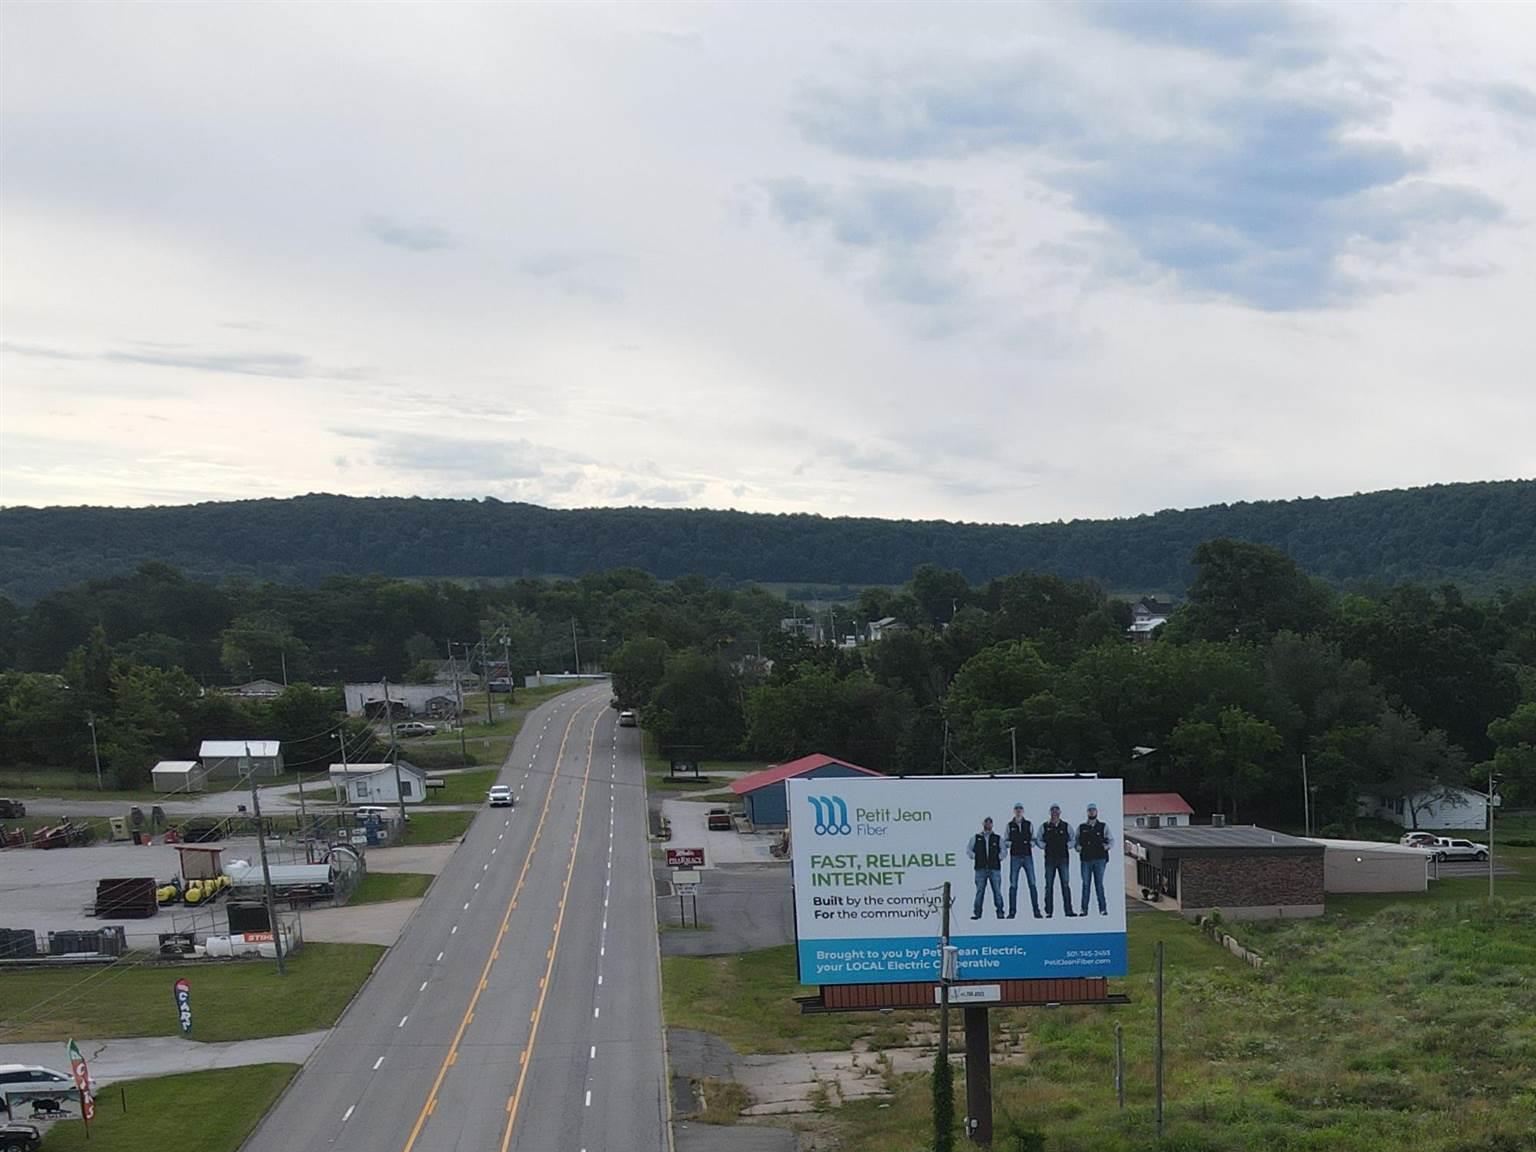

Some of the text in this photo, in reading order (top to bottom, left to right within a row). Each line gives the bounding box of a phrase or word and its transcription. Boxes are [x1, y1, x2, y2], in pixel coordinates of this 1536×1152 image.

[856, 808, 932, 822] Petit Jean
[857, 824, 888, 836] Fiber
[811, 853, 956, 870] FAST, RELIABLE
[812, 871, 905, 886] INTERNET
[813, 894, 956, 908] Built by the communy
[814, 907, 930, 920] For the community
[816, 950, 865, 961] Brought
[867, 950, 879, 958] to
[882, 950, 903, 960] you
[905, 948, 920, 959] by
[957, 948, 979, 956] ean
[981, 945, 1027, 956] Electric,
[816, 958, 1000, 974] your LOCAL Electric Cperative
